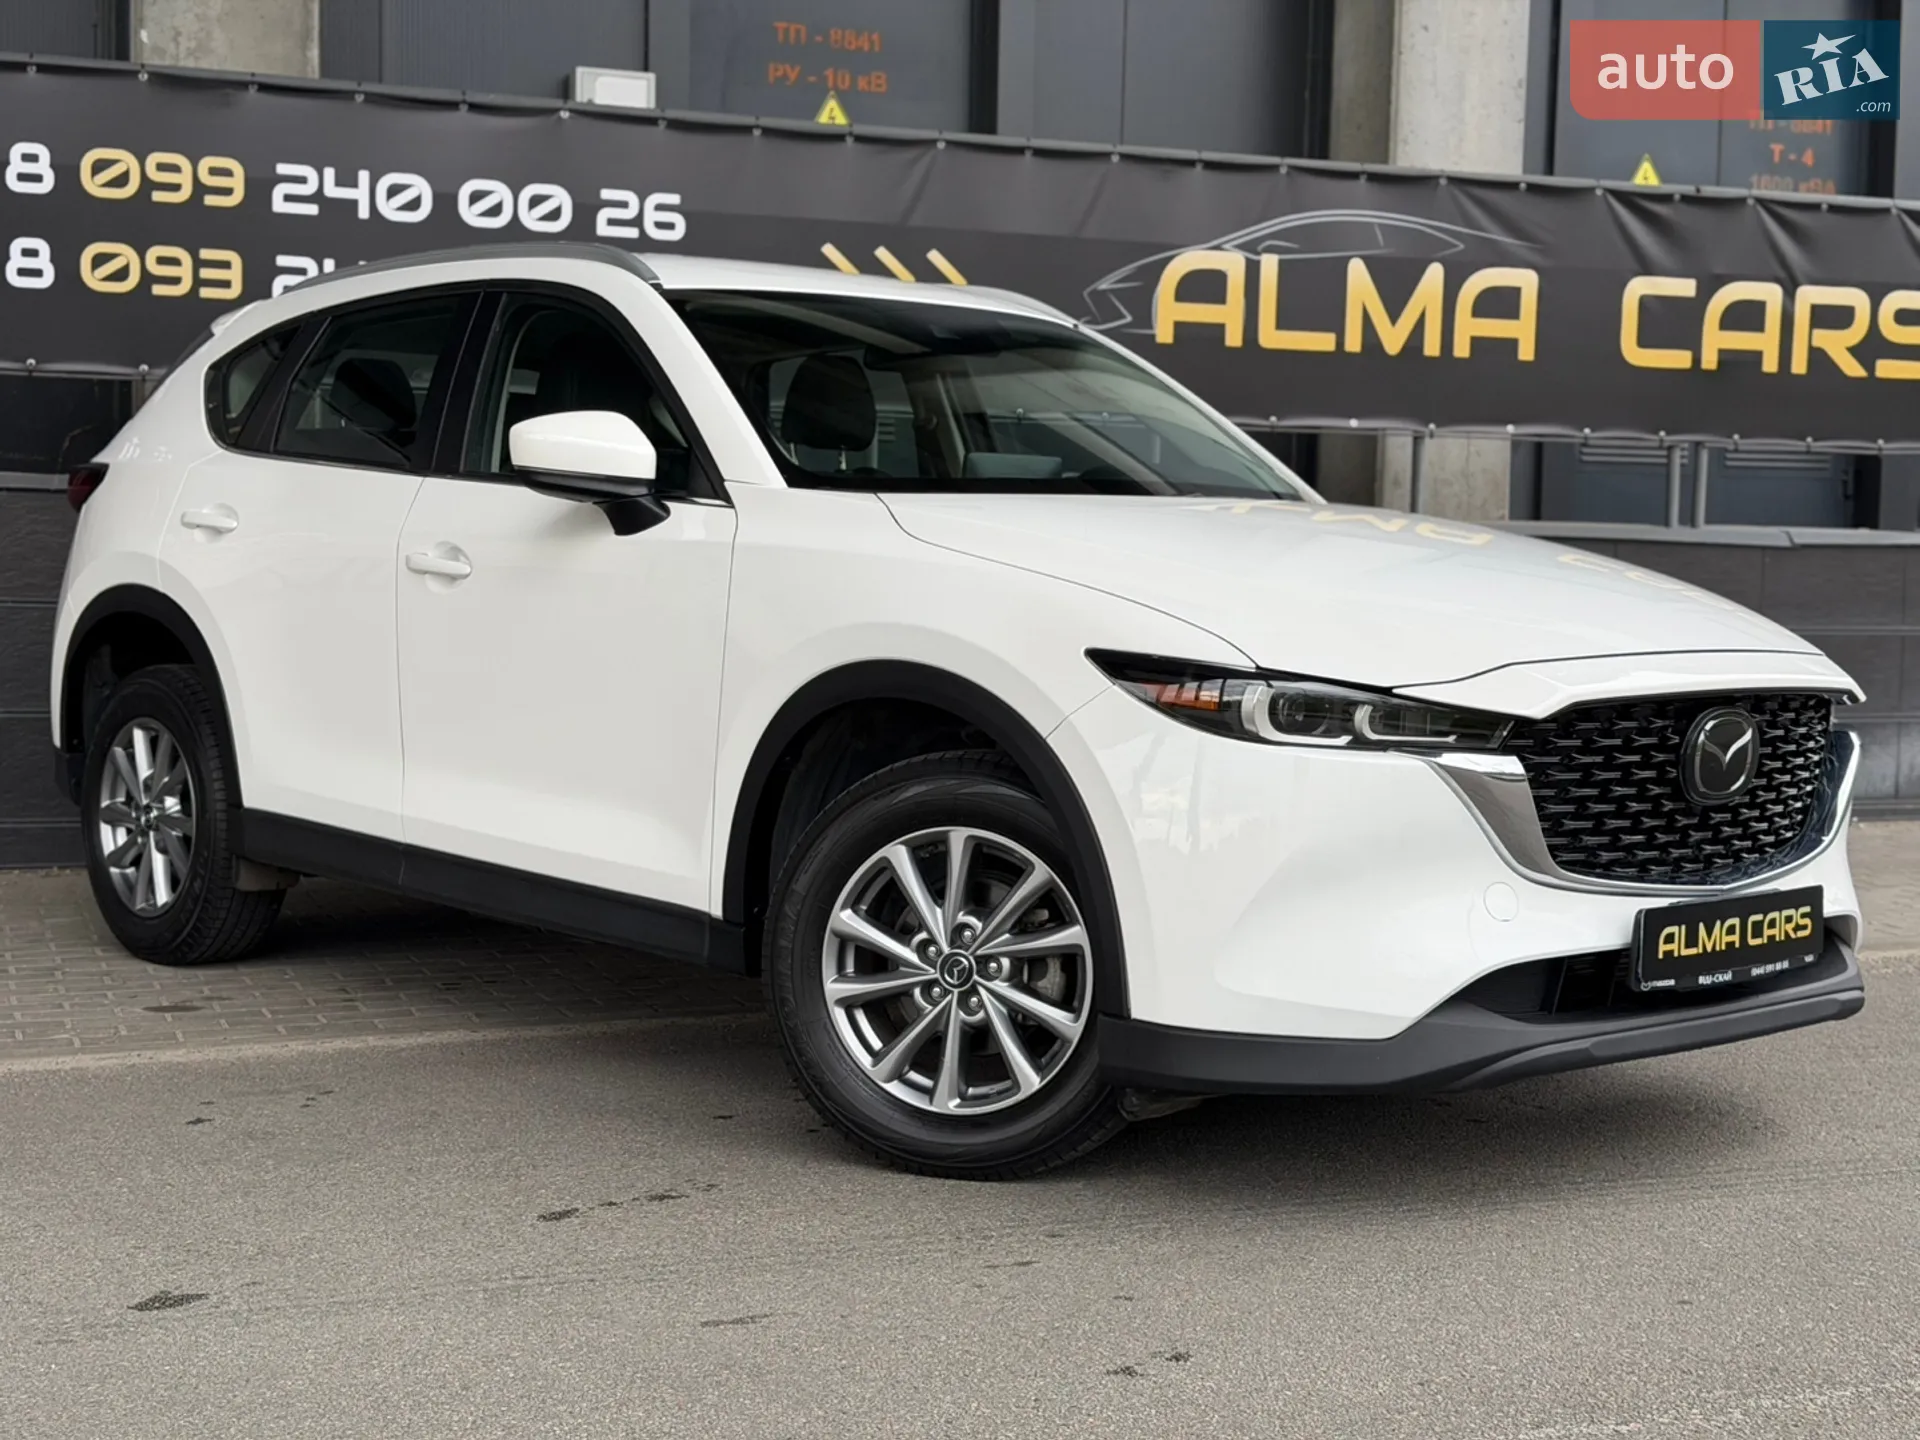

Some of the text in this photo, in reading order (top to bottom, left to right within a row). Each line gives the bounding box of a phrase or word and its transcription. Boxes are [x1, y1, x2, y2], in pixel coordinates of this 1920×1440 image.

[5, 142, 686, 241] 8 099 240 00 26
[5, 236, 55, 290] 8
[80, 242, 243, 300] 093
[1155, 249, 1539, 362] ALMA
[1658, 905, 1812, 959] ALMA CARS
